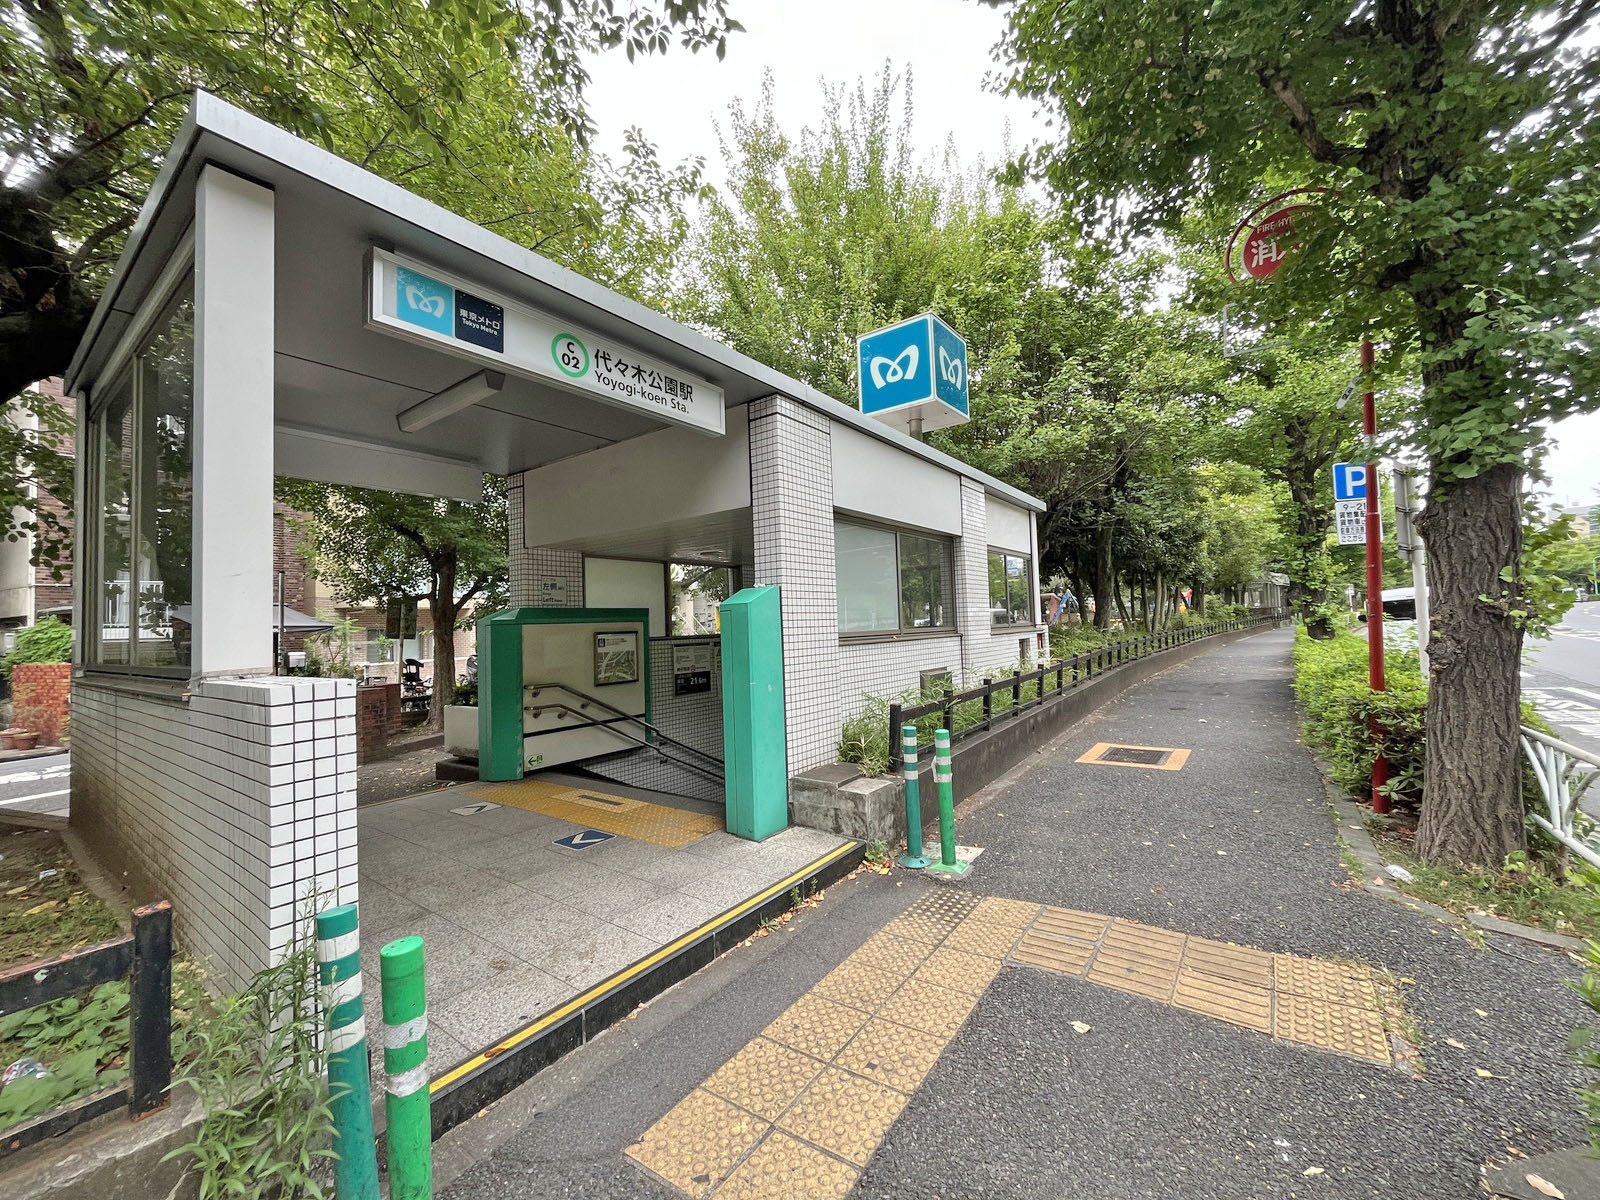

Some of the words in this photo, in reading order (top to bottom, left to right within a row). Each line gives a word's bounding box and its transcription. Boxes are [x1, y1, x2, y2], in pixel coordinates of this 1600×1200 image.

[1257, 221, 1276, 234] FIRE
[459, 308, 500, 330] 東京メトロ
[462, 317, 480, 329] Tokyo
[480, 324, 498, 336] Metro
[566, 341, 575, 354] C
[561, 352, 580, 370] 02
[594, 348, 694, 402] 代々木公園駅
[594, 370, 668, 406] Yoyogi-koen
[670, 398, 690, 414] Sta.
[1345, 466, 1367, 497] P
